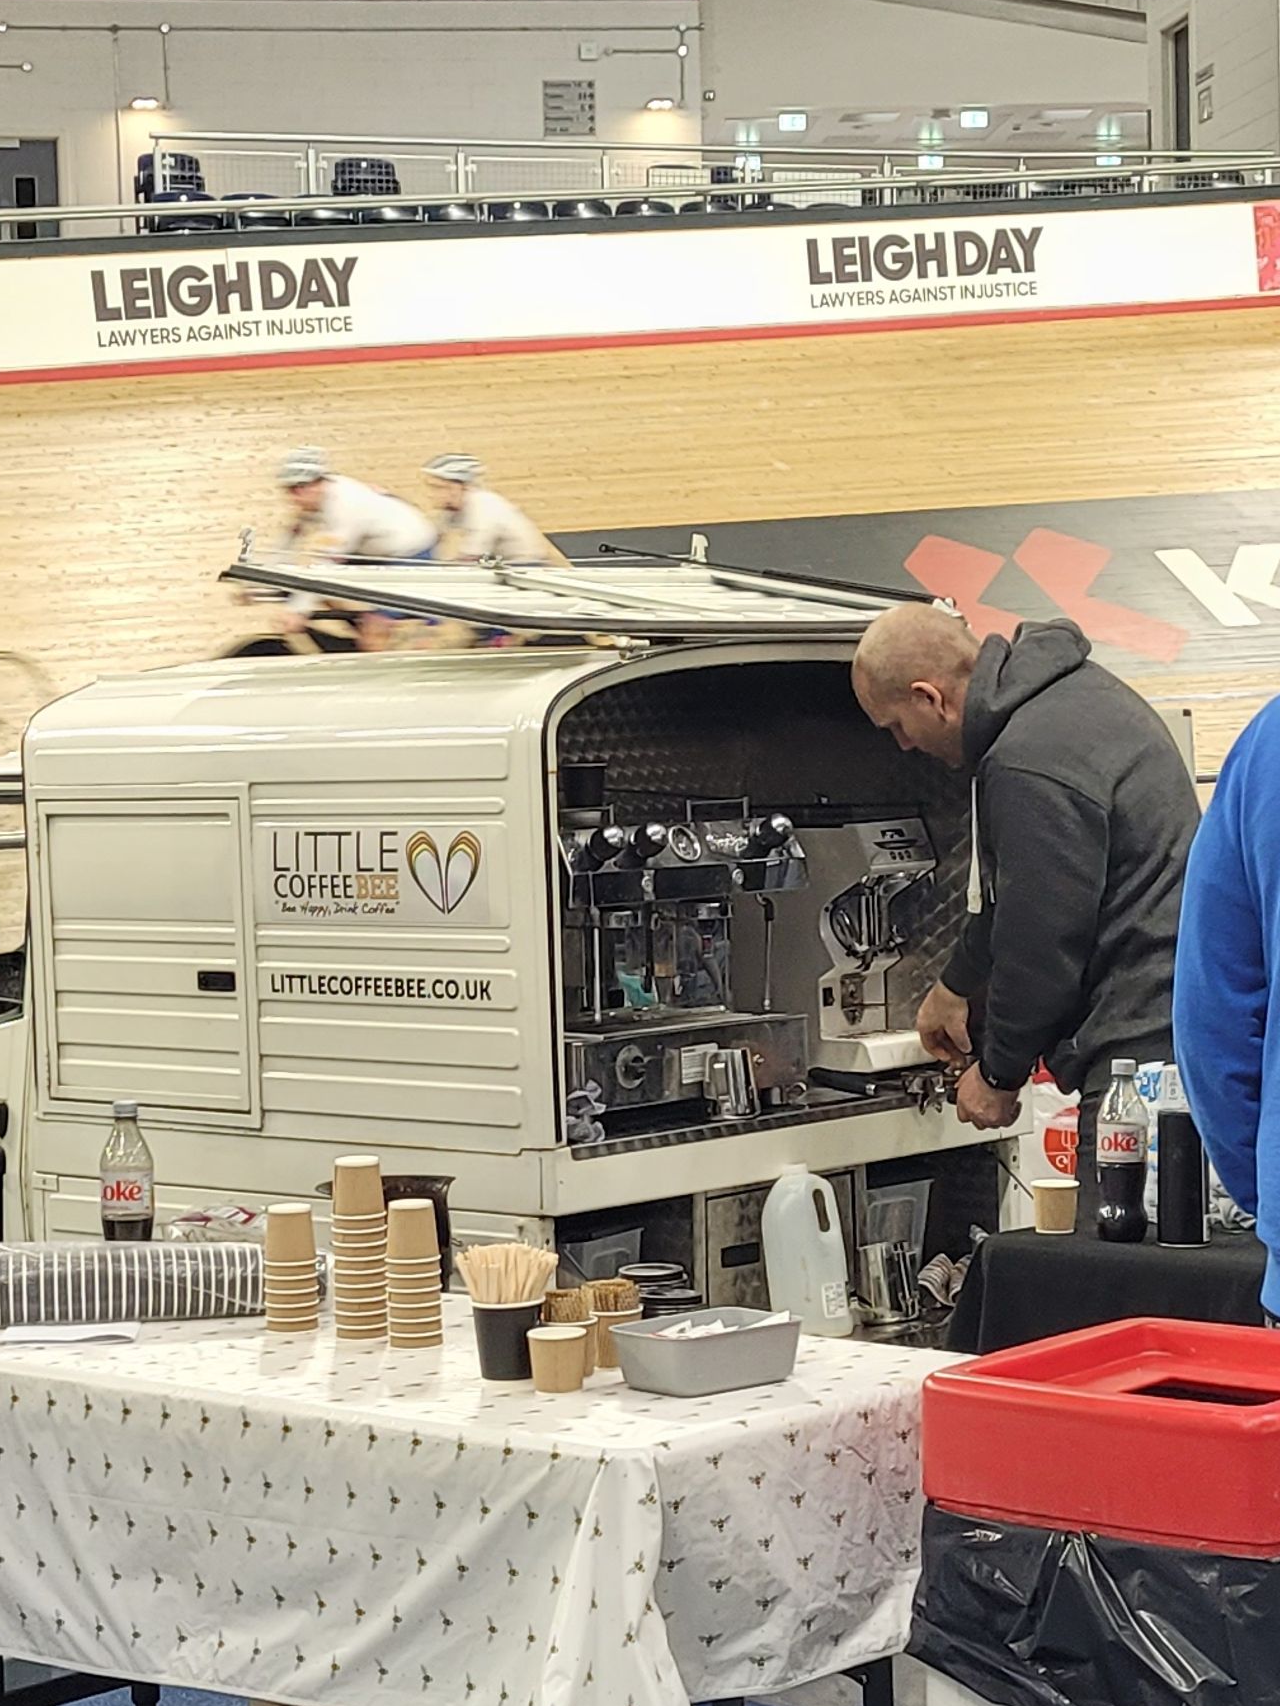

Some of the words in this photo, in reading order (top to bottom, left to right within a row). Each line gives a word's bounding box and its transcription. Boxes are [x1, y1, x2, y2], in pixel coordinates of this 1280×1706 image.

[806, 232, 948, 285] LEIGH
[954, 226, 1043, 276] DAY
[91, 264, 253, 322] LEIGH
[258, 256, 358, 310] DAY
[811, 290, 885, 309] LAWYERS
[889, 286, 956, 305] AGAINST
[960, 281, 1038, 300] INJUSTICE
[97, 326, 181, 348] LAWYERS
[186, 320, 262, 342] AGAINST
[266, 316, 353, 336] INJUSTICE
[273, 830, 399, 873] LITTLE
[270, 973, 492, 1001] LITTLECOFFEEBEE.CO.UK
